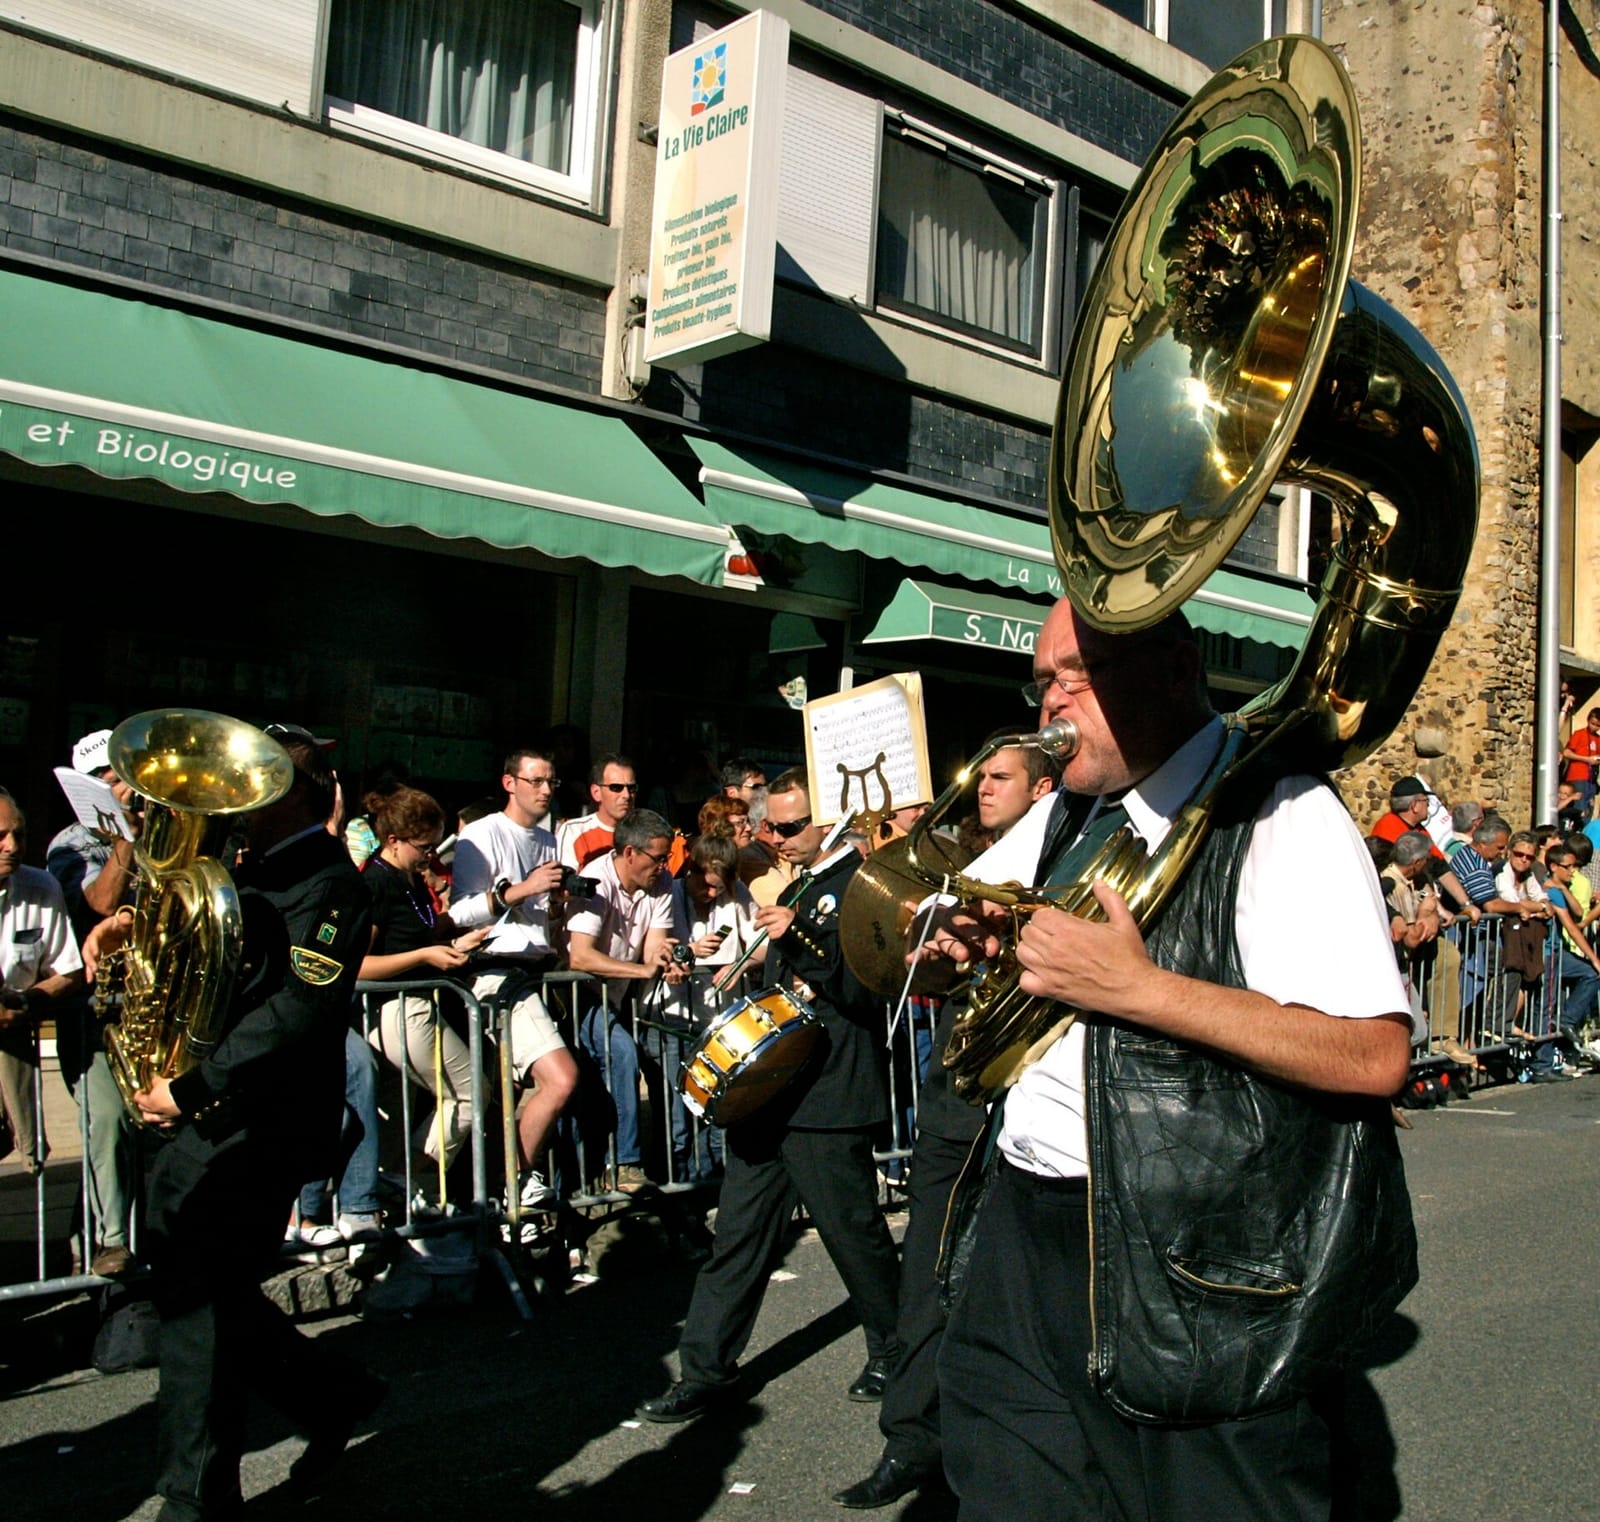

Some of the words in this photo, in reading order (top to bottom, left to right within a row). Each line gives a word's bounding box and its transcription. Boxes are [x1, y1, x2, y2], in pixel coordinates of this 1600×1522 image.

[665, 137, 680, 160] La
[683, 125, 704, 152] Vie
[706, 105, 748, 141] Claire
[664, 208, 703, 232] Alimentation
[705, 194, 738, 216] biologique
[671, 228, 698, 247] Produits
[700, 215, 728, 235] naturels
[664, 248, 690, 266] Traiteur
[705, 255, 716, 268] bio
[663, 283, 690, 302] Produits
[696, 283, 736, 307] alimentaires
[654, 320, 680, 339] Produits
[27, 421, 75, 446] et
[96, 429, 297, 488] Biologique
[1007, 560, 1029, 583] La
[1047, 574, 1065, 592] vi
[964, 614, 987, 643] S.
[1000, 619, 1040, 651] Na
